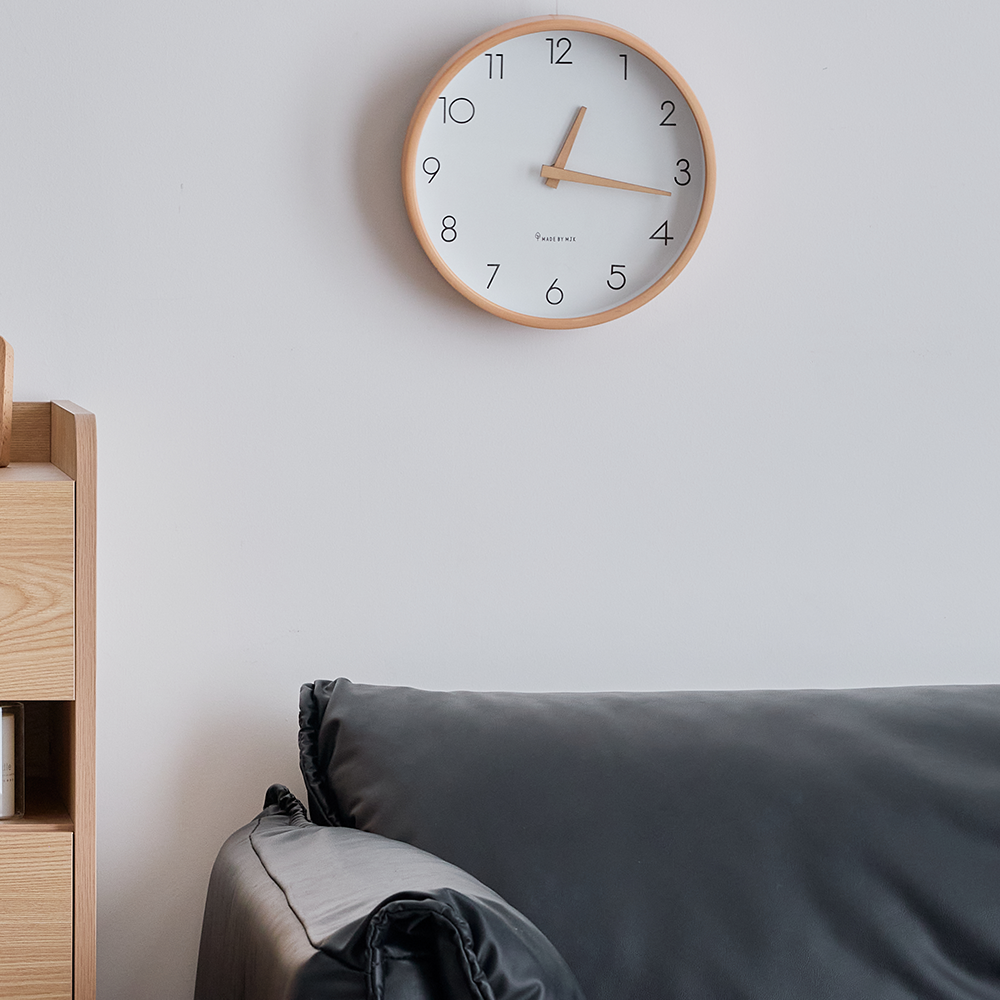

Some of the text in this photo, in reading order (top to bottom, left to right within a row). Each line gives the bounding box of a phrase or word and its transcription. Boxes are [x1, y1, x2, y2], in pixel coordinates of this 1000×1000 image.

[546, 38, 572, 64] 12
[485, 54, 503, 79] 11
[619, 54, 627, 80] 1
[439, 97, 475, 124] 10
[660, 101, 676, 126] 2
[423, 157, 440, 183] 9
[674, 159, 691, 186] 3
[441, 216, 457, 242] 8
[649, 220, 674, 246] 4
[487, 264, 500, 289] 7
[607, 265, 626, 290] 5
[546, 279, 563, 305] 6
